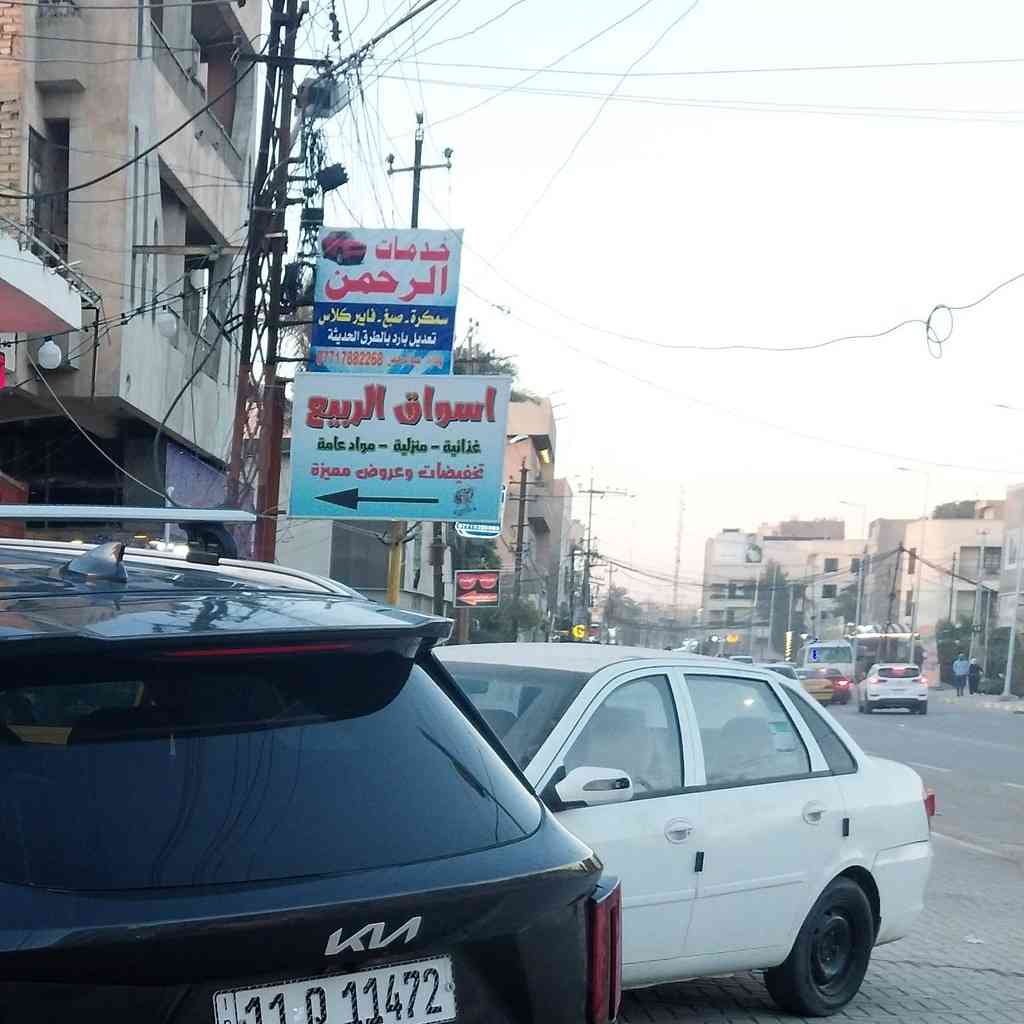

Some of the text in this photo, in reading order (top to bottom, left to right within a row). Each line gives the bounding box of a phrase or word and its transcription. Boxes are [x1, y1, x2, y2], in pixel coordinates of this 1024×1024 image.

[375, 235, 450, 262] خدمات
[324, 264, 449, 302] الرحمن
[327, 327, 360, 345] الحديثة
[409, 331, 437, 347] تعديل
[306, 384, 497, 429] اسواق الربيع
[317, 436, 346, 451] عامة
[348, 437, 375, 454] مواد
[393, 437, 428, 456] منزلية
[310, 462, 485, 484] تخفيضات وعروض مميزة
